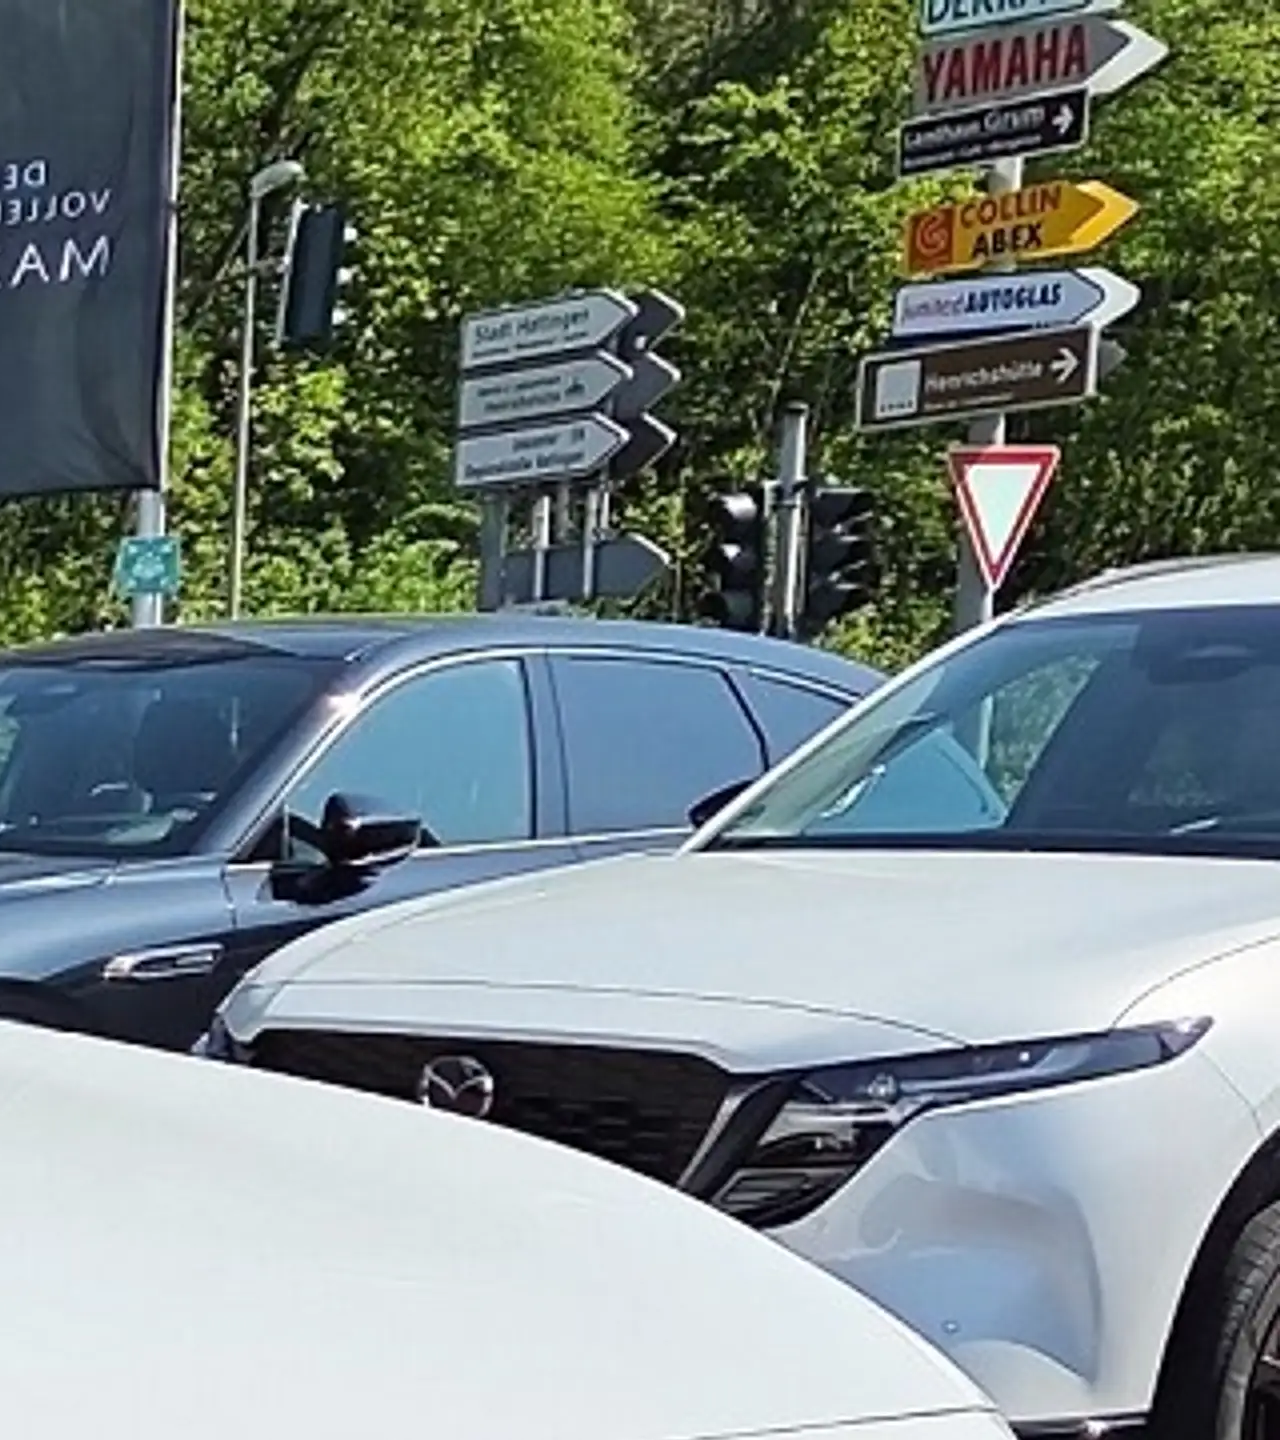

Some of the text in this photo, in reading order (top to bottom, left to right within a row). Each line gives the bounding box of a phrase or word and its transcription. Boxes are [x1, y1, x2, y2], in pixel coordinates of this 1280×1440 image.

[923, 24, 1088, 102] YAMAHA
[961, 185, 1062, 230] COLLIN
[972, 221, 1042, 260] ABEX
